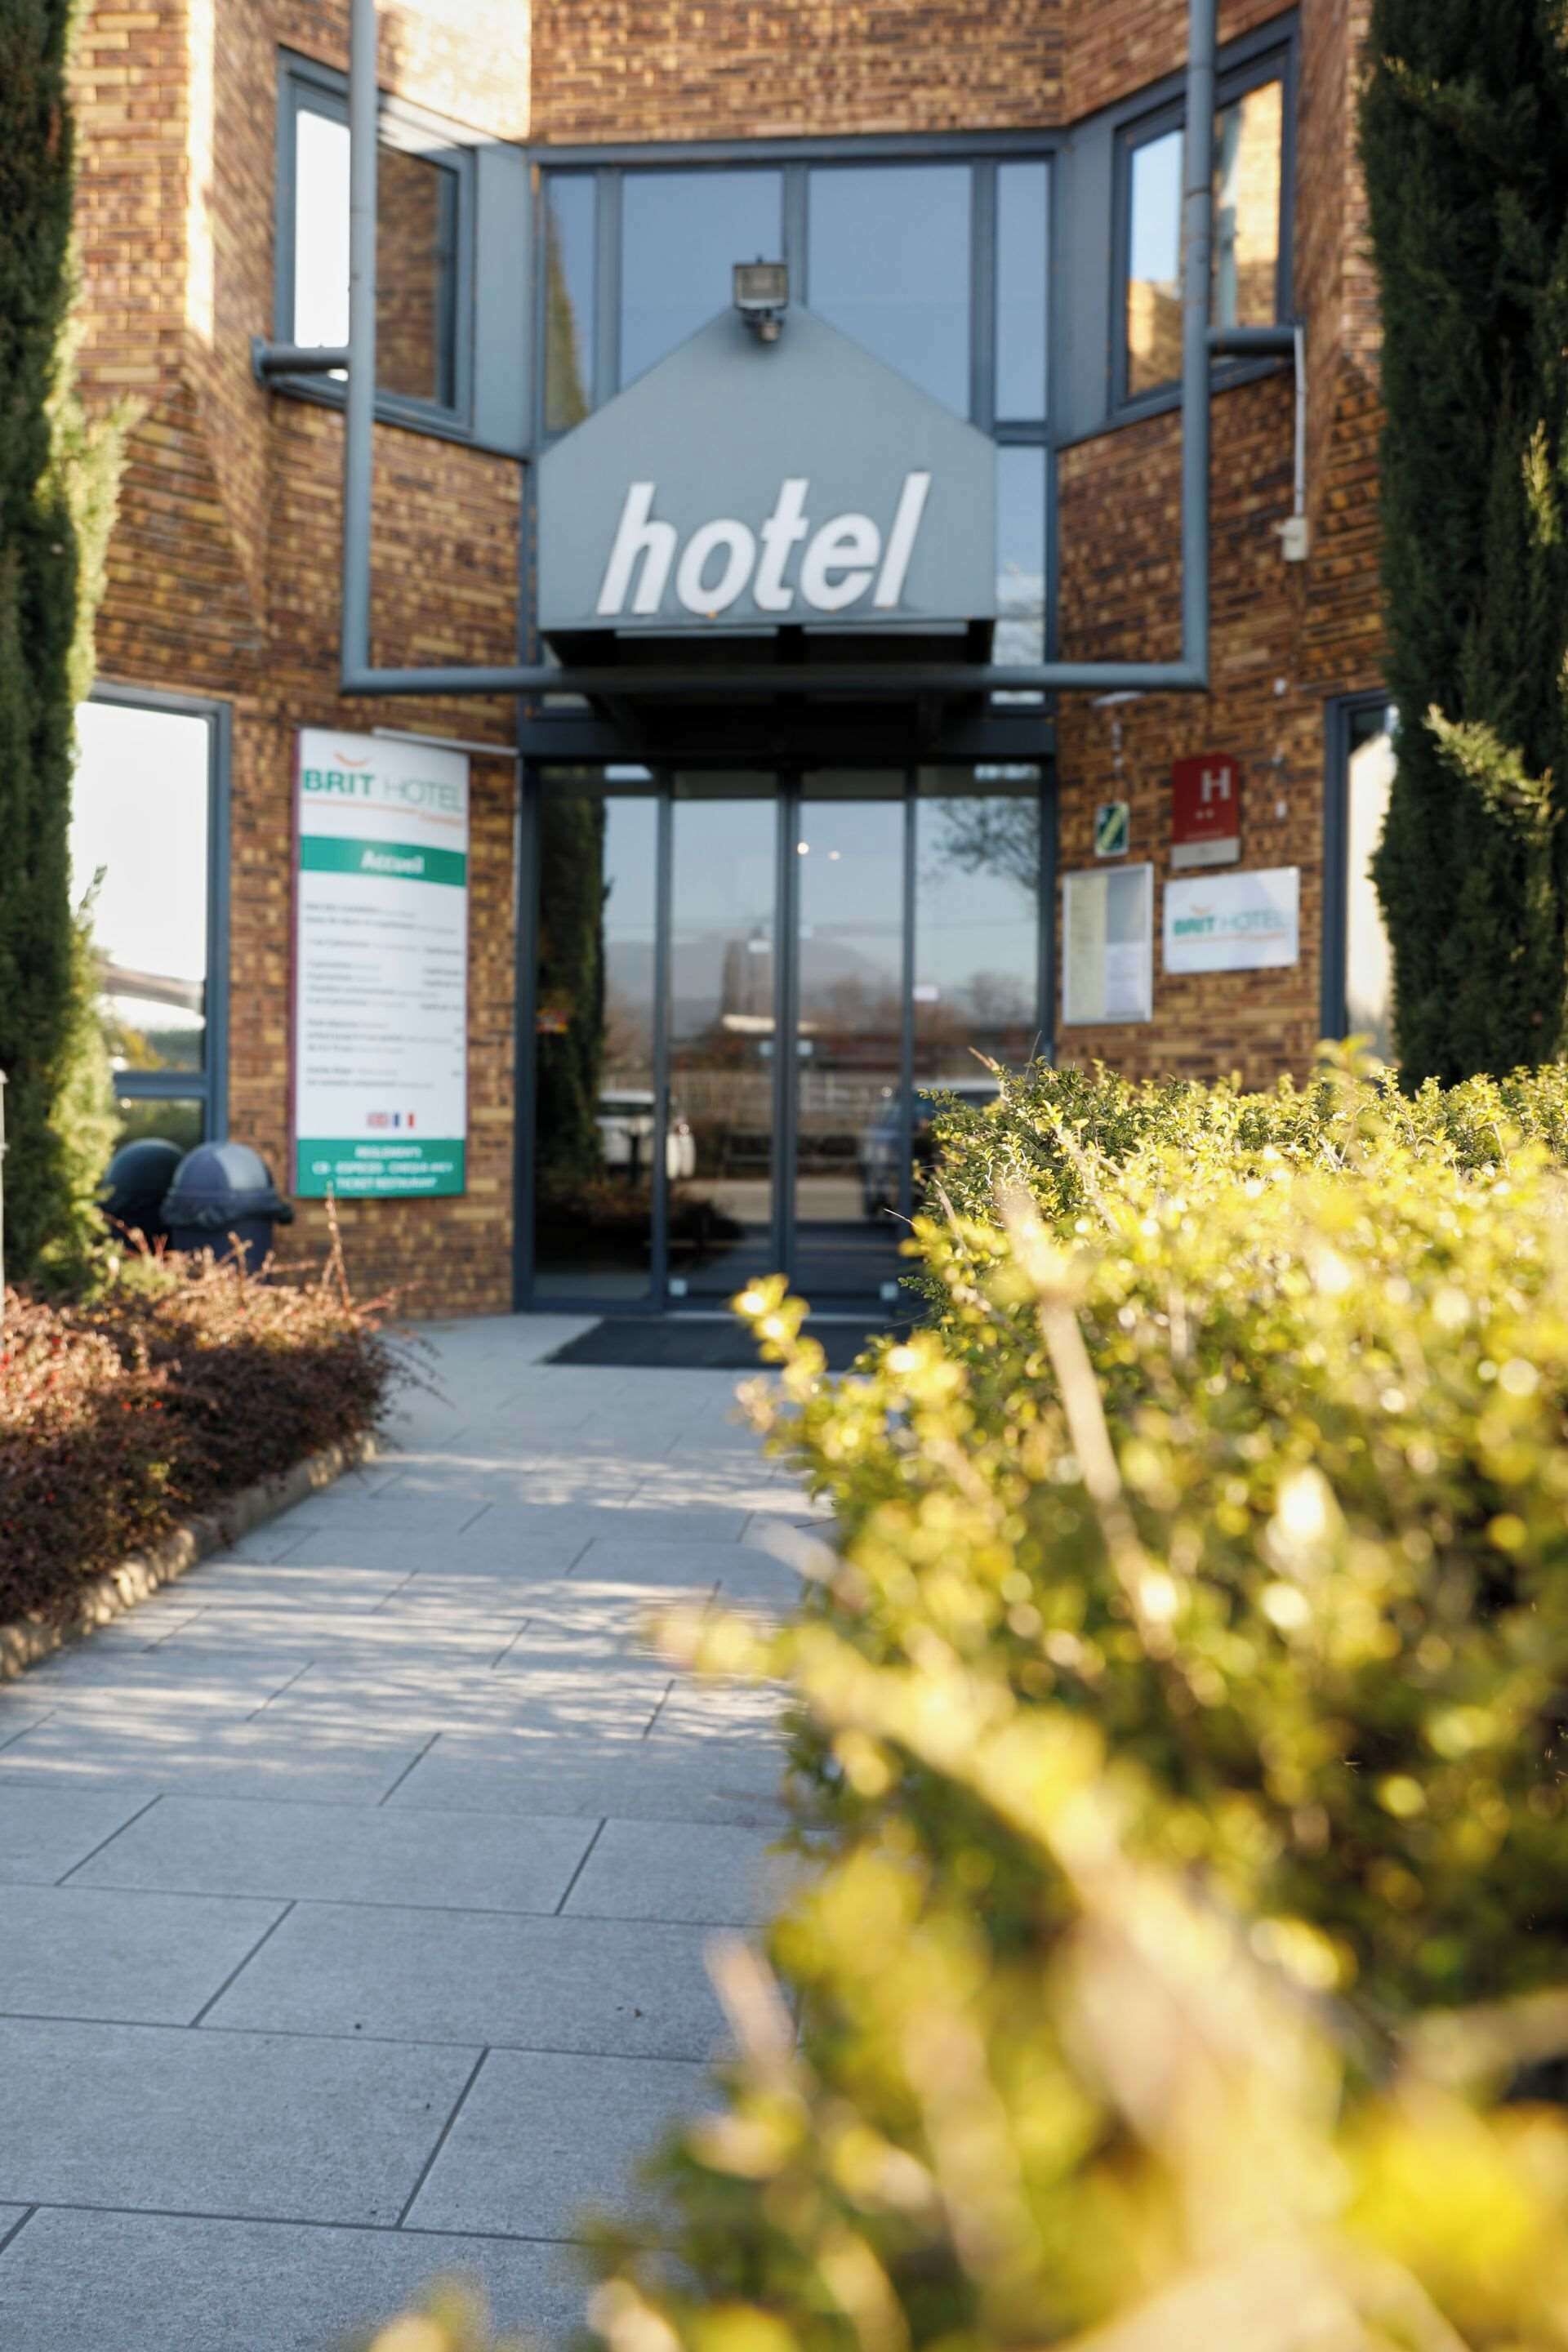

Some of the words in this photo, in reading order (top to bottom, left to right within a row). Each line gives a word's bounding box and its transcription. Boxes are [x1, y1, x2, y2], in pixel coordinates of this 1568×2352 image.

[596, 471, 931, 617] hotel
[302, 768, 375, 796] BRIT
[384, 777, 463, 813] HOTEL
[1201, 767, 1232, 803] H
